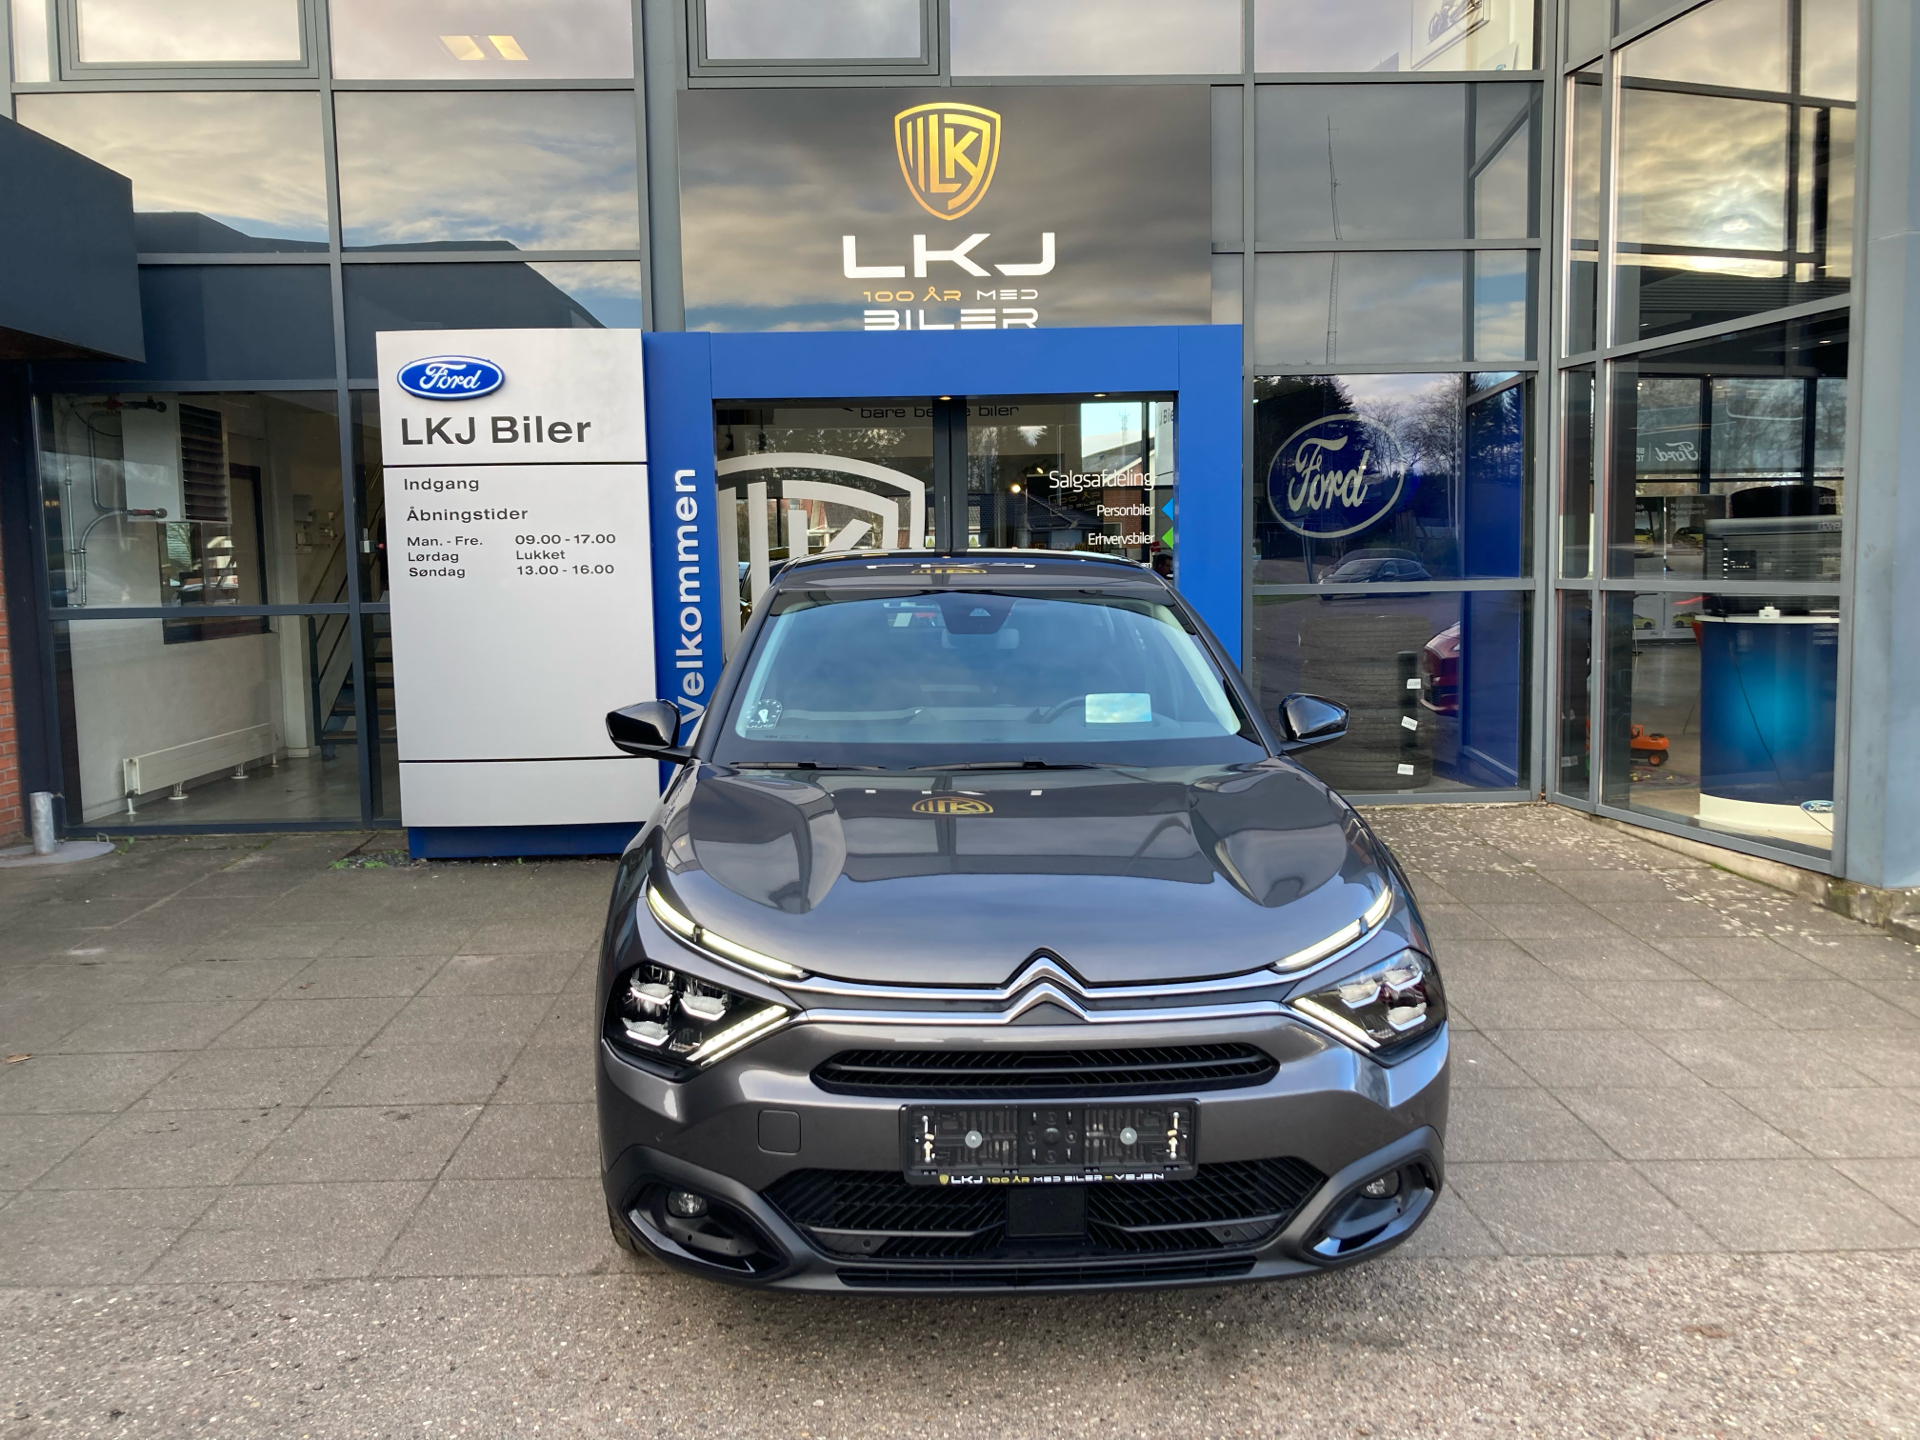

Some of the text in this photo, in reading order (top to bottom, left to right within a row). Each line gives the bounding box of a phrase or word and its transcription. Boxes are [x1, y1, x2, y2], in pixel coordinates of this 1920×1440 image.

[842, 232, 1056, 279] LKJ
[863, 286, 1039, 302] 100 ÅR MED
[863, 307, 1039, 331] BILER
[419, 362, 482, 390] Ford
[860, 407, 906, 419] bare
[978, 405, 1019, 417] biler
[401, 415, 592, 446] LKJ Biler
[1048, 469, 1155, 492] Salgsafdeling
[1287, 435, 1371, 512] Ford
[403, 477, 480, 493] Indgang
[406, 505, 529, 524] Åbningstider
[1096, 504, 1155, 517] Personbiler
[406, 536, 443, 547] Man.
[454, 535, 483, 546] Fre.
[514, 534, 562, 545] 09.00
[573, 533, 617, 545] 17.00
[1088, 532, 1155, 546] Erhvervsbiler
[407, 550, 566, 564] Lørdag Lukket
[408, 567, 466, 579] Søndag
[516, 564, 559, 576] 13.00
[571, 564, 615, 575] 16.00
[674, 469, 706, 725] Velkommen
[950, 1175, 984, 1185] LKJ
[986, 1176, 1010, 1184] 100
[1033, 1175, 1061, 1183] MED
[1064, 1174, 1103, 1183] BILER
[1114, 1173, 1165, 1181] VEJEN
